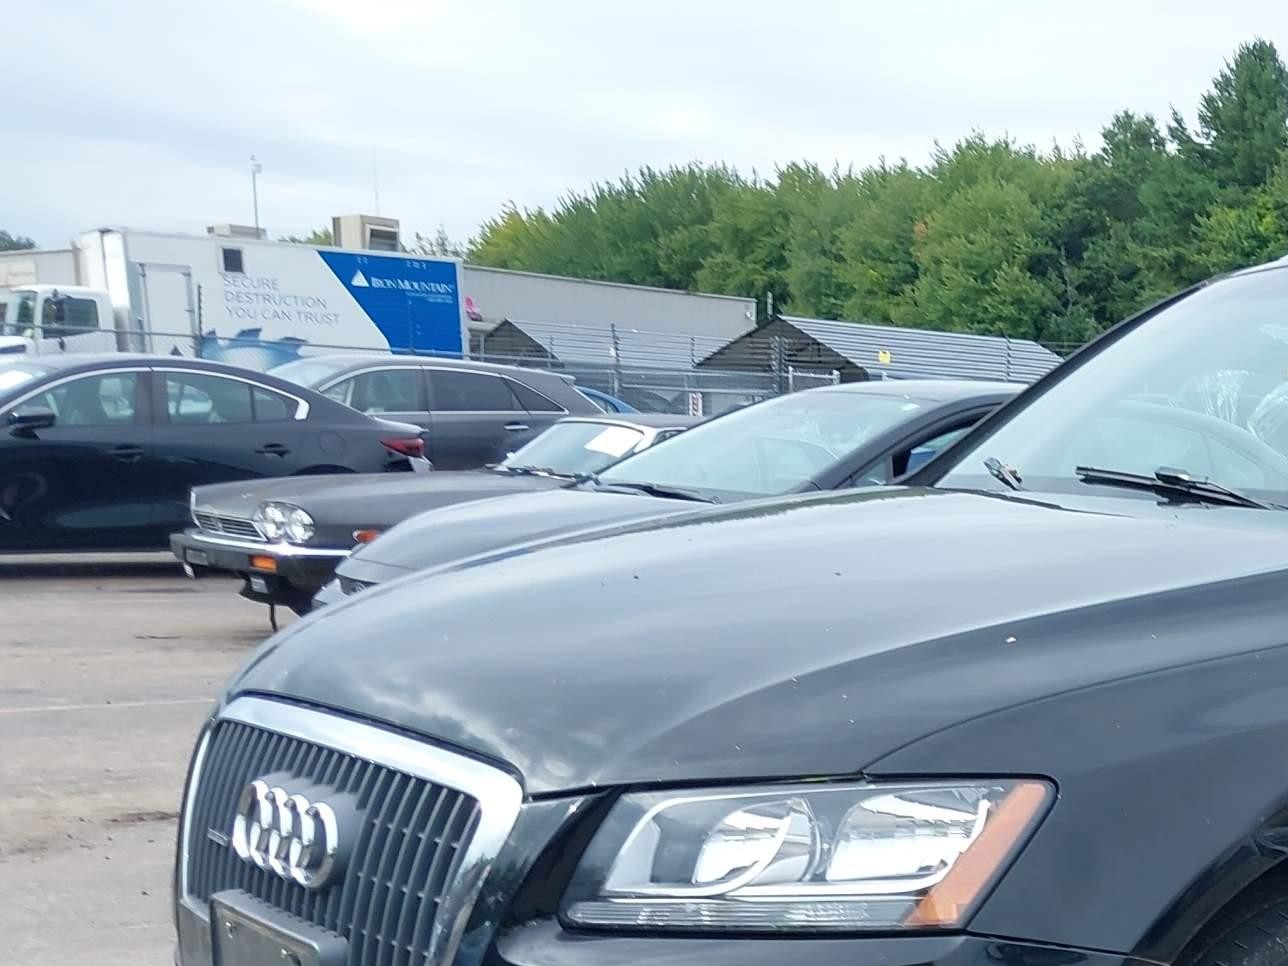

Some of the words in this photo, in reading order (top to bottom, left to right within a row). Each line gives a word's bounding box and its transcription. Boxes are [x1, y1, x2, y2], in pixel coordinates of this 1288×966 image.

[223, 275, 279, 290] SECURE
[370, 276, 397, 289] IRON
[397, 279, 453, 293] MOUNTAIN
[224, 290, 328, 310] DESTRUCTION
[225, 306, 256, 320] YOU
[261, 309, 292, 321] CAN
[296, 311, 340, 325] TRUST
